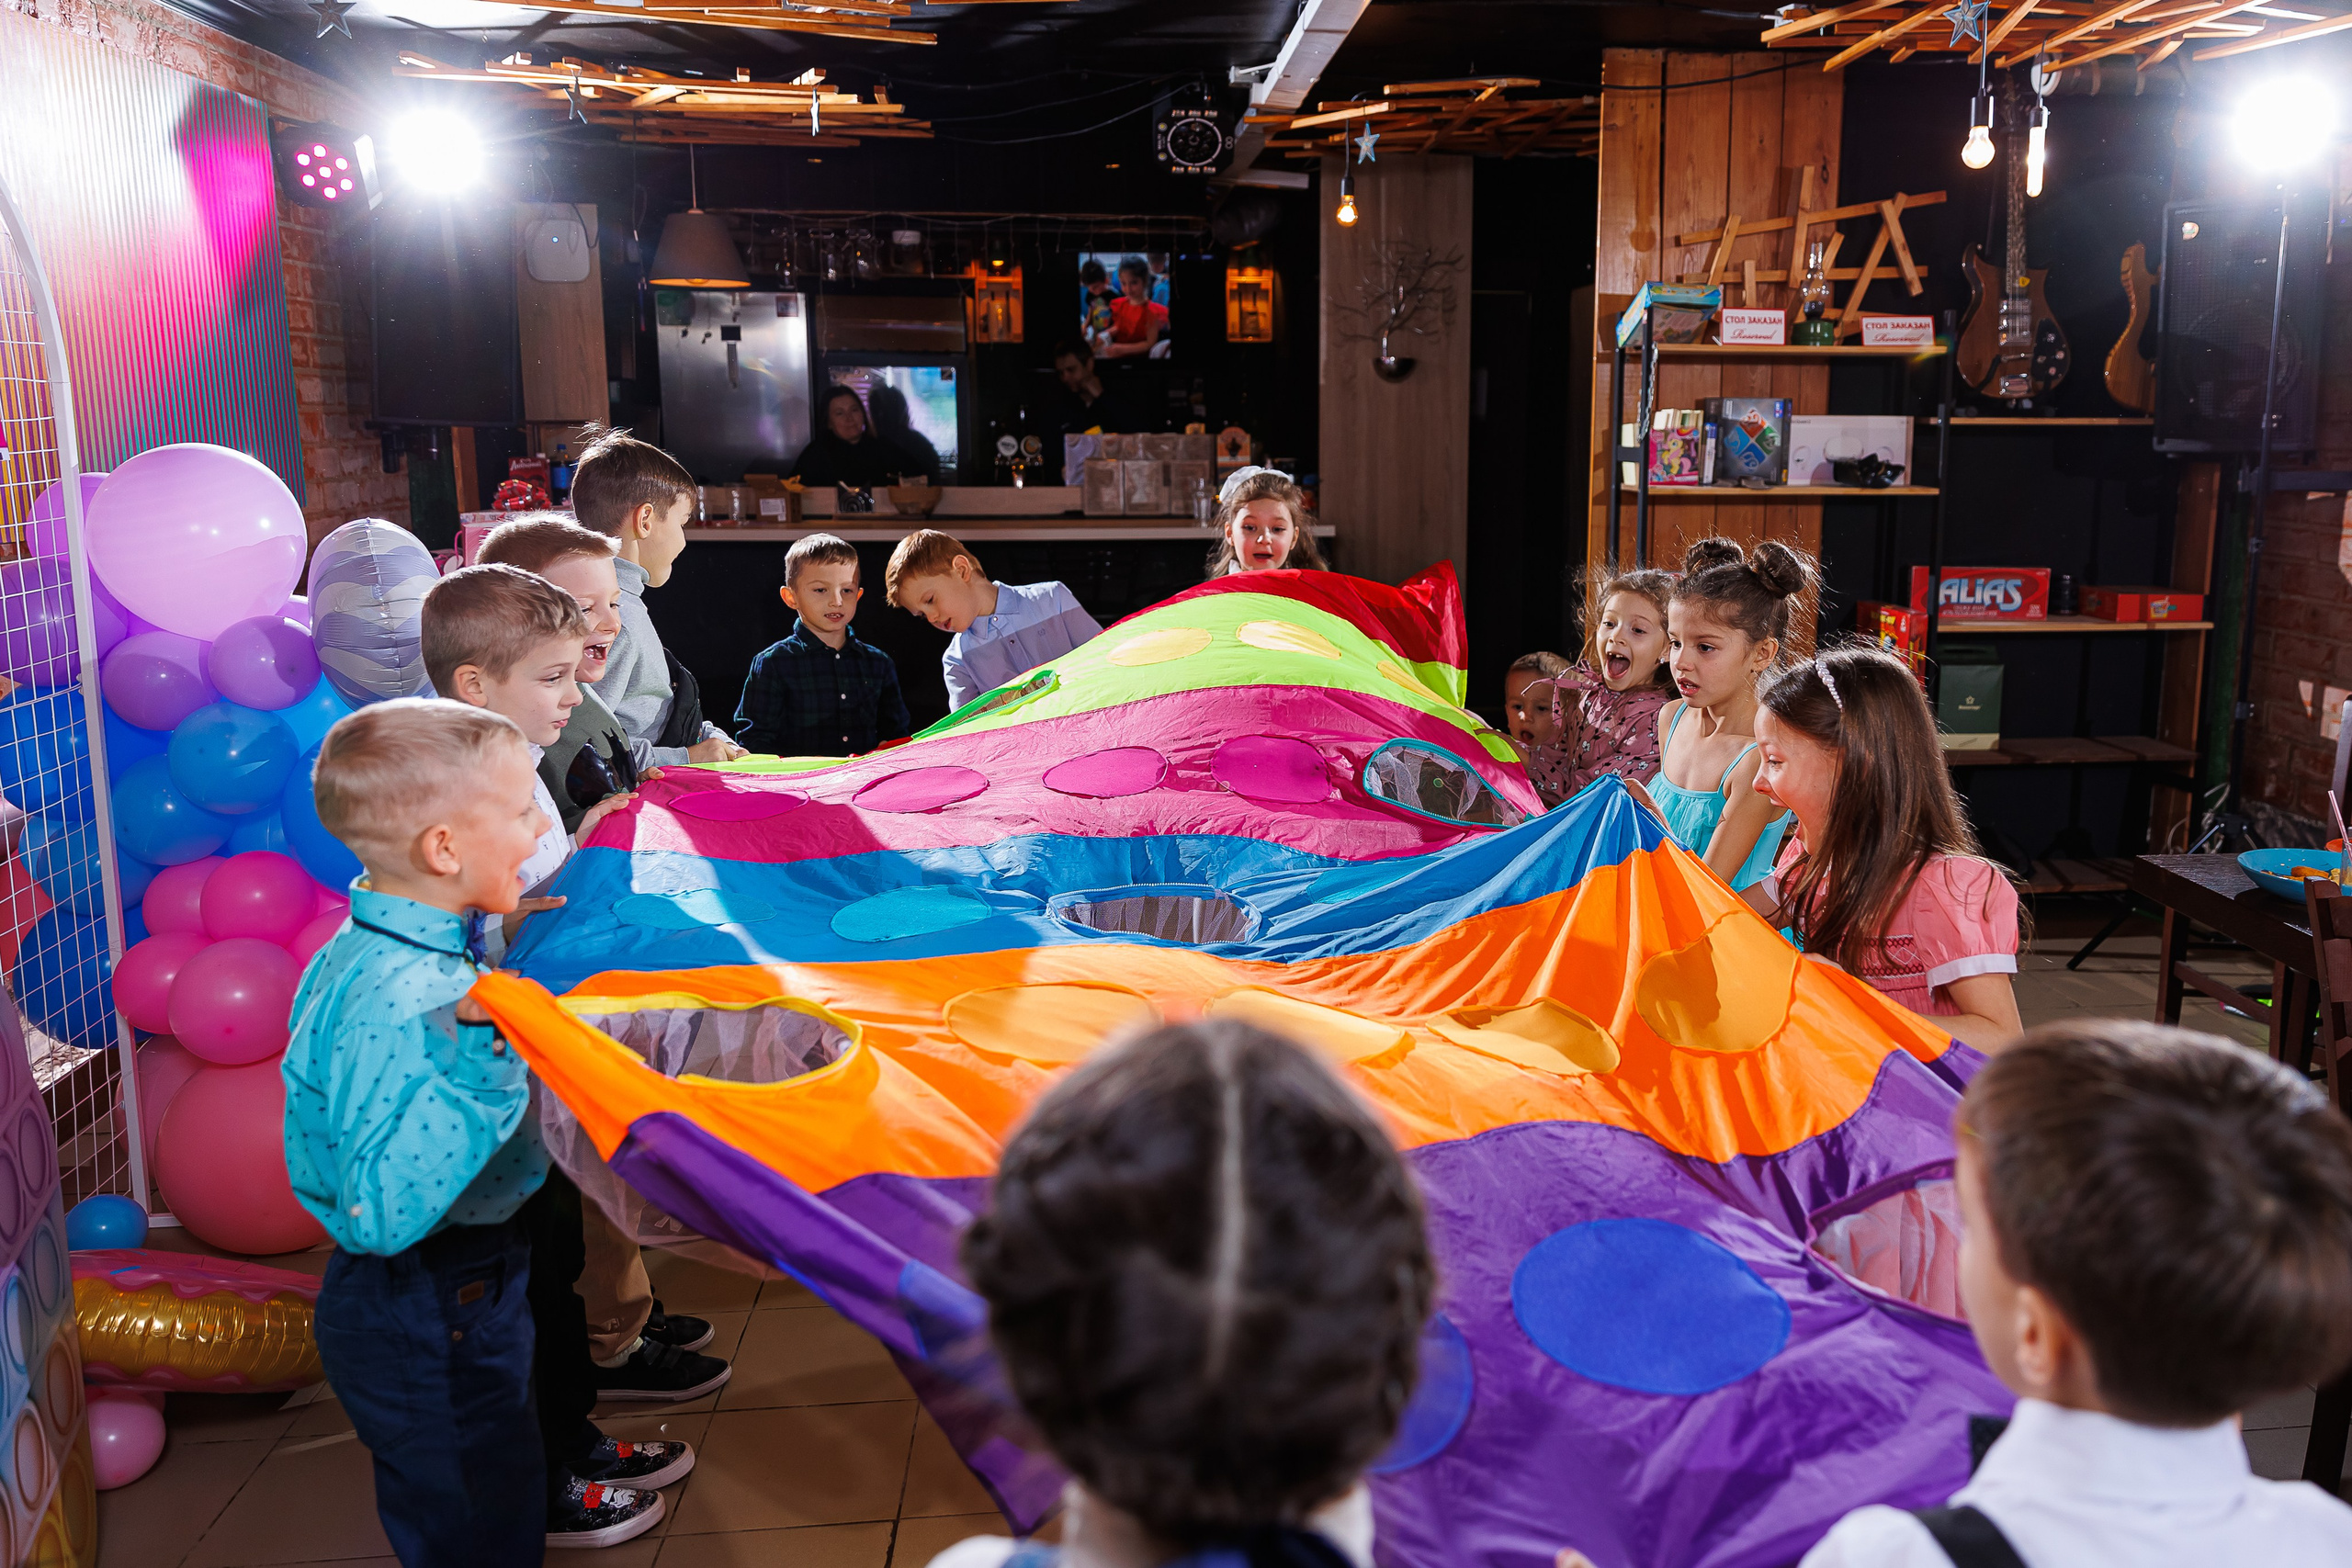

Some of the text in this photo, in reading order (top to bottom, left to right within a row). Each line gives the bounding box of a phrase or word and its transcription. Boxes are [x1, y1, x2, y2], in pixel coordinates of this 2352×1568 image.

[1724, 315, 1783, 325] СТОЛ ЗАКАЗАН
[1865, 321, 1931, 331] СТОЛ ЗАКАЗАН
